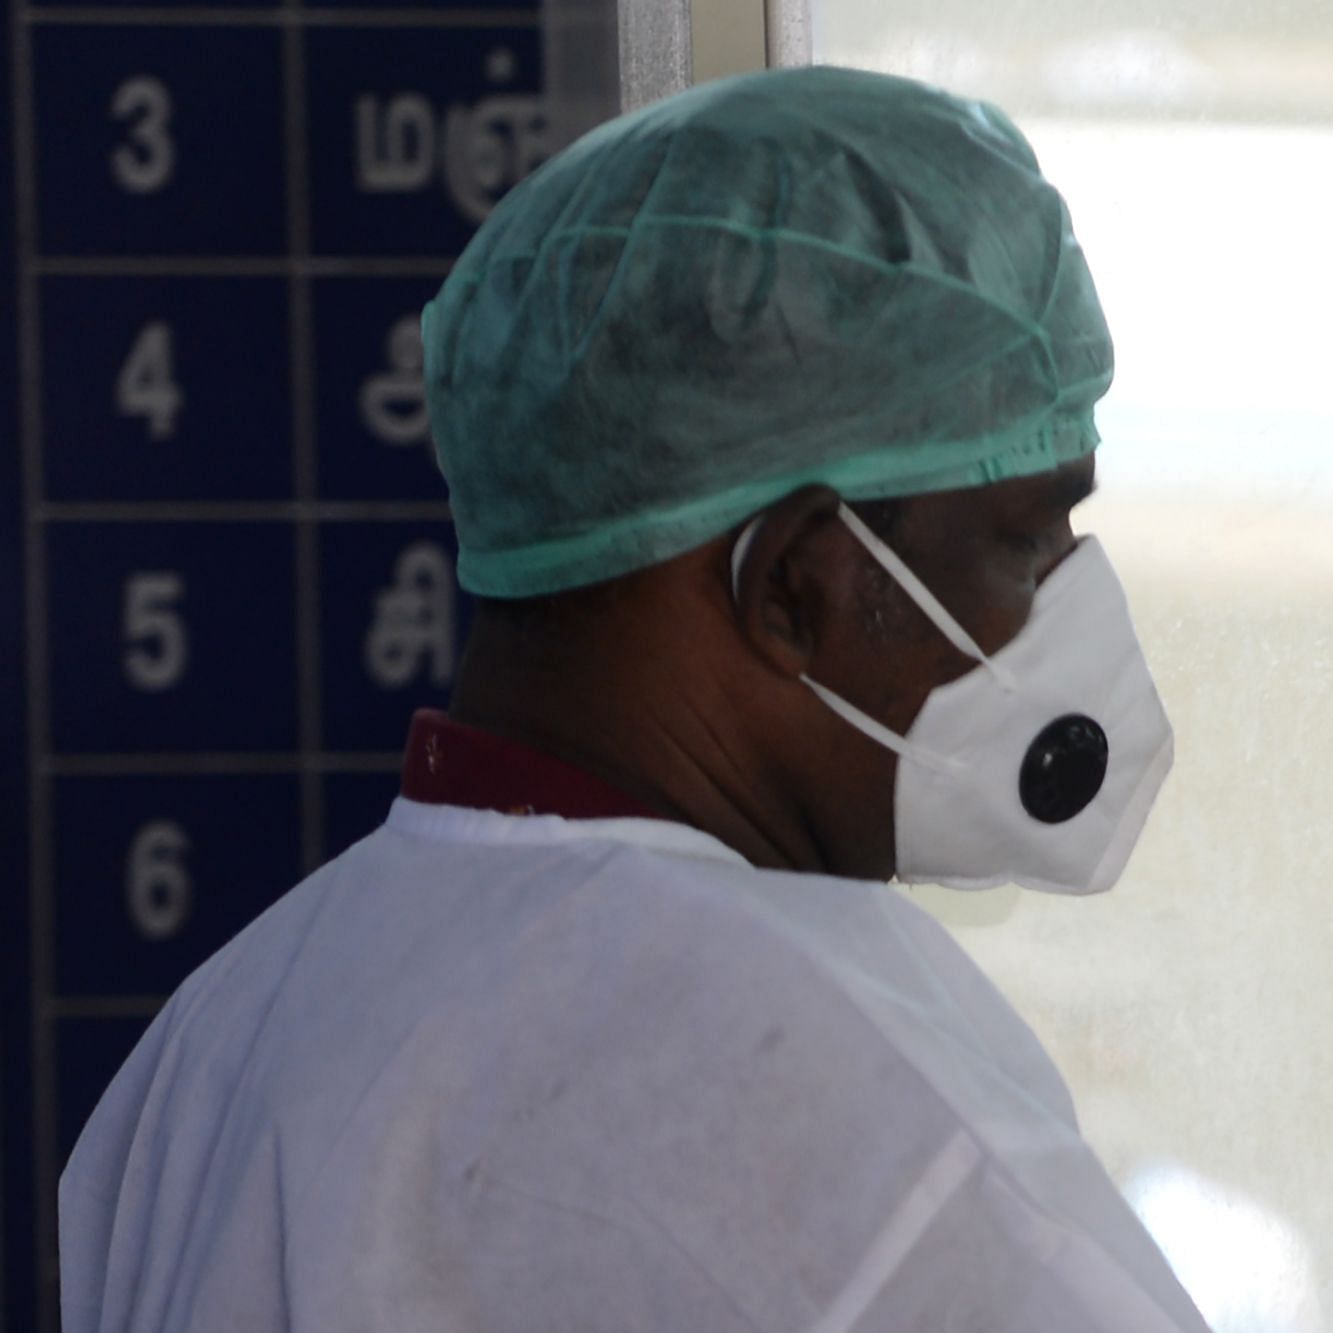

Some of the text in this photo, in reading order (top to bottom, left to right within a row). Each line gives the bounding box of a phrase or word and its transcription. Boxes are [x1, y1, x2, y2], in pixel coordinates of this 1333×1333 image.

[110, 75, 174, 194] 3
[116, 320, 183, 442] 4
[121, 570, 189, 691] 5
[123, 818, 194, 940] 6
